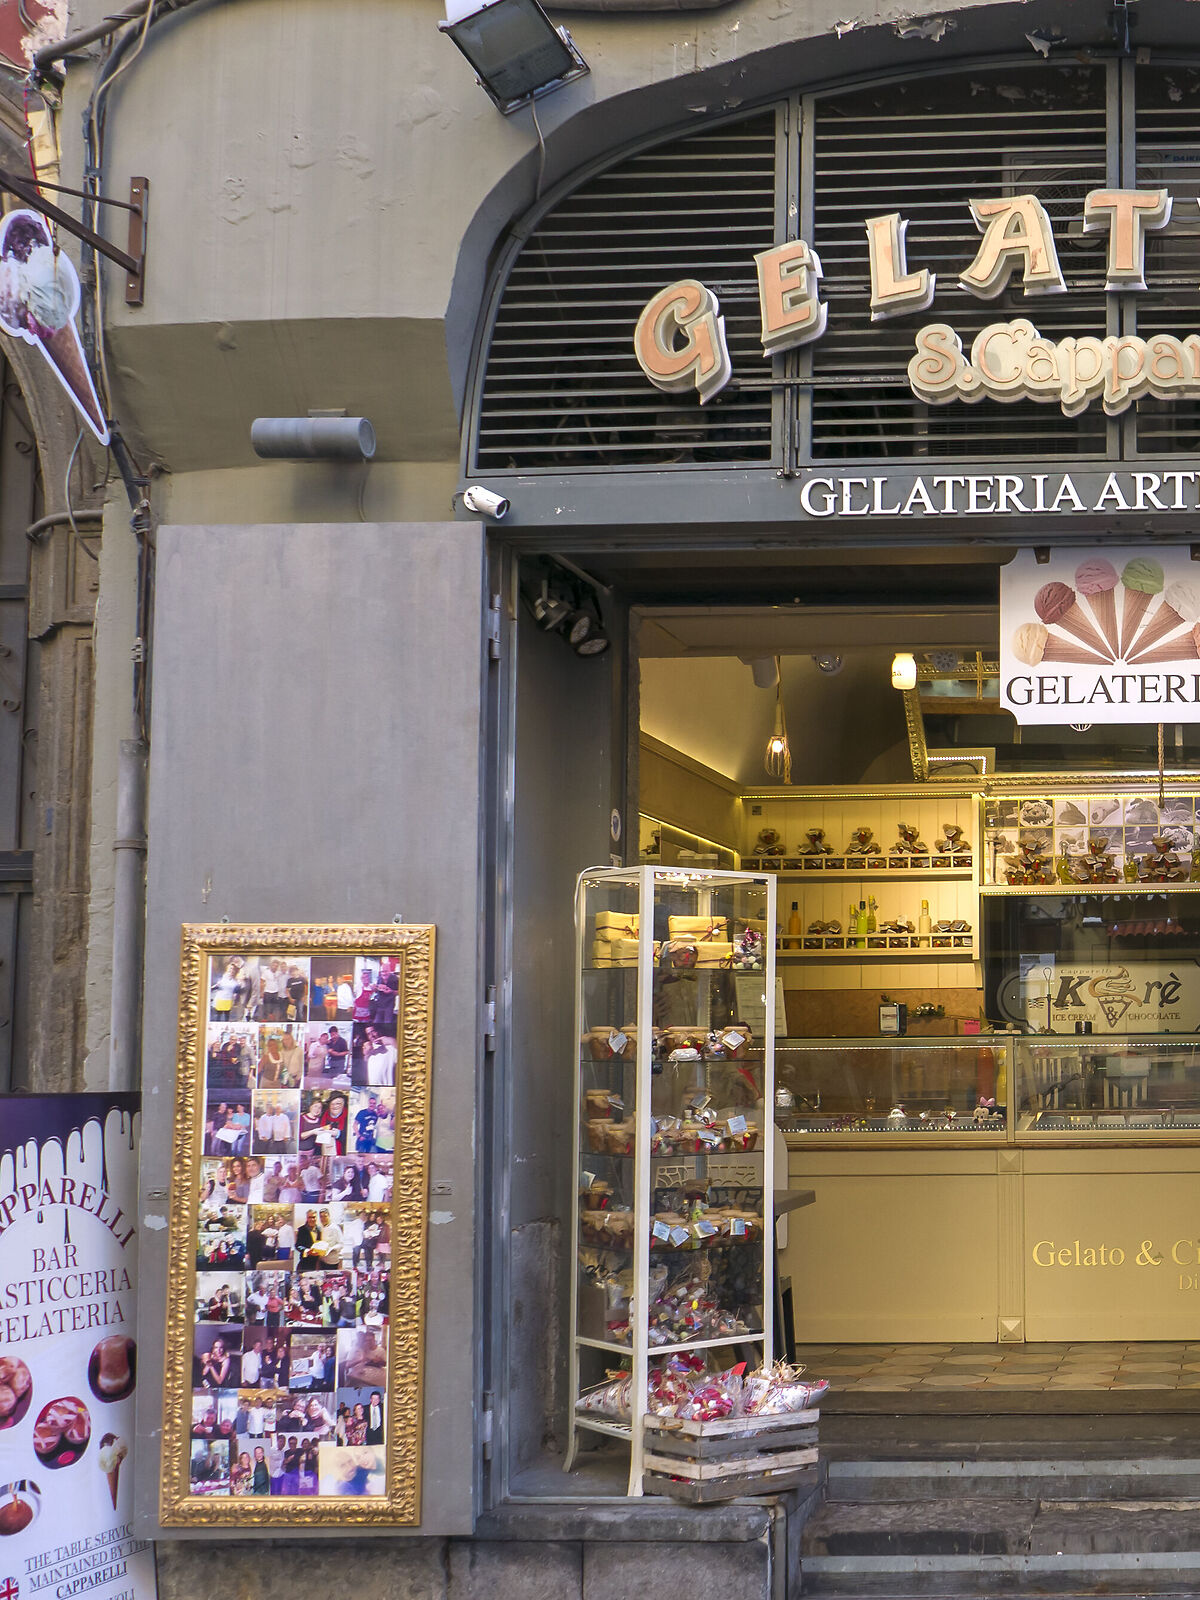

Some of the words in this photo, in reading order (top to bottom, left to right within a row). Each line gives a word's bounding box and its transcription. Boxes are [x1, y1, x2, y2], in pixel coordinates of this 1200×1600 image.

[799, 473, 1087, 517] GELATERIA
[1052, 1013, 1065, 1021] ICE
[1067, 1013, 1096, 1021] CREAM
[1127, 1012, 1181, 1020] CHOCOLATE
[0, 1177, 136, 1249] PPARELLI
[32, 1244, 79, 1273] BAR
[1032, 1240, 1125, 1267] Gelato
[1135, 1240, 1162, 1266] &
[0, 1267, 132, 1310] STICCERIA
[1179, 1274, 1199, 1290] Di
[0, 1300, 125, 1343] ELATERIA
[24, 1551, 52, 1571] THE
[54, 1537, 92, 1560] TABLE
[95, 1522, 134, 1546] SERVIC
[29, 1552, 108, 1590] MAINTAINED
[110, 1545, 126, 1560] BY
[56, 1561, 128, 1599] CAPPARELLI
